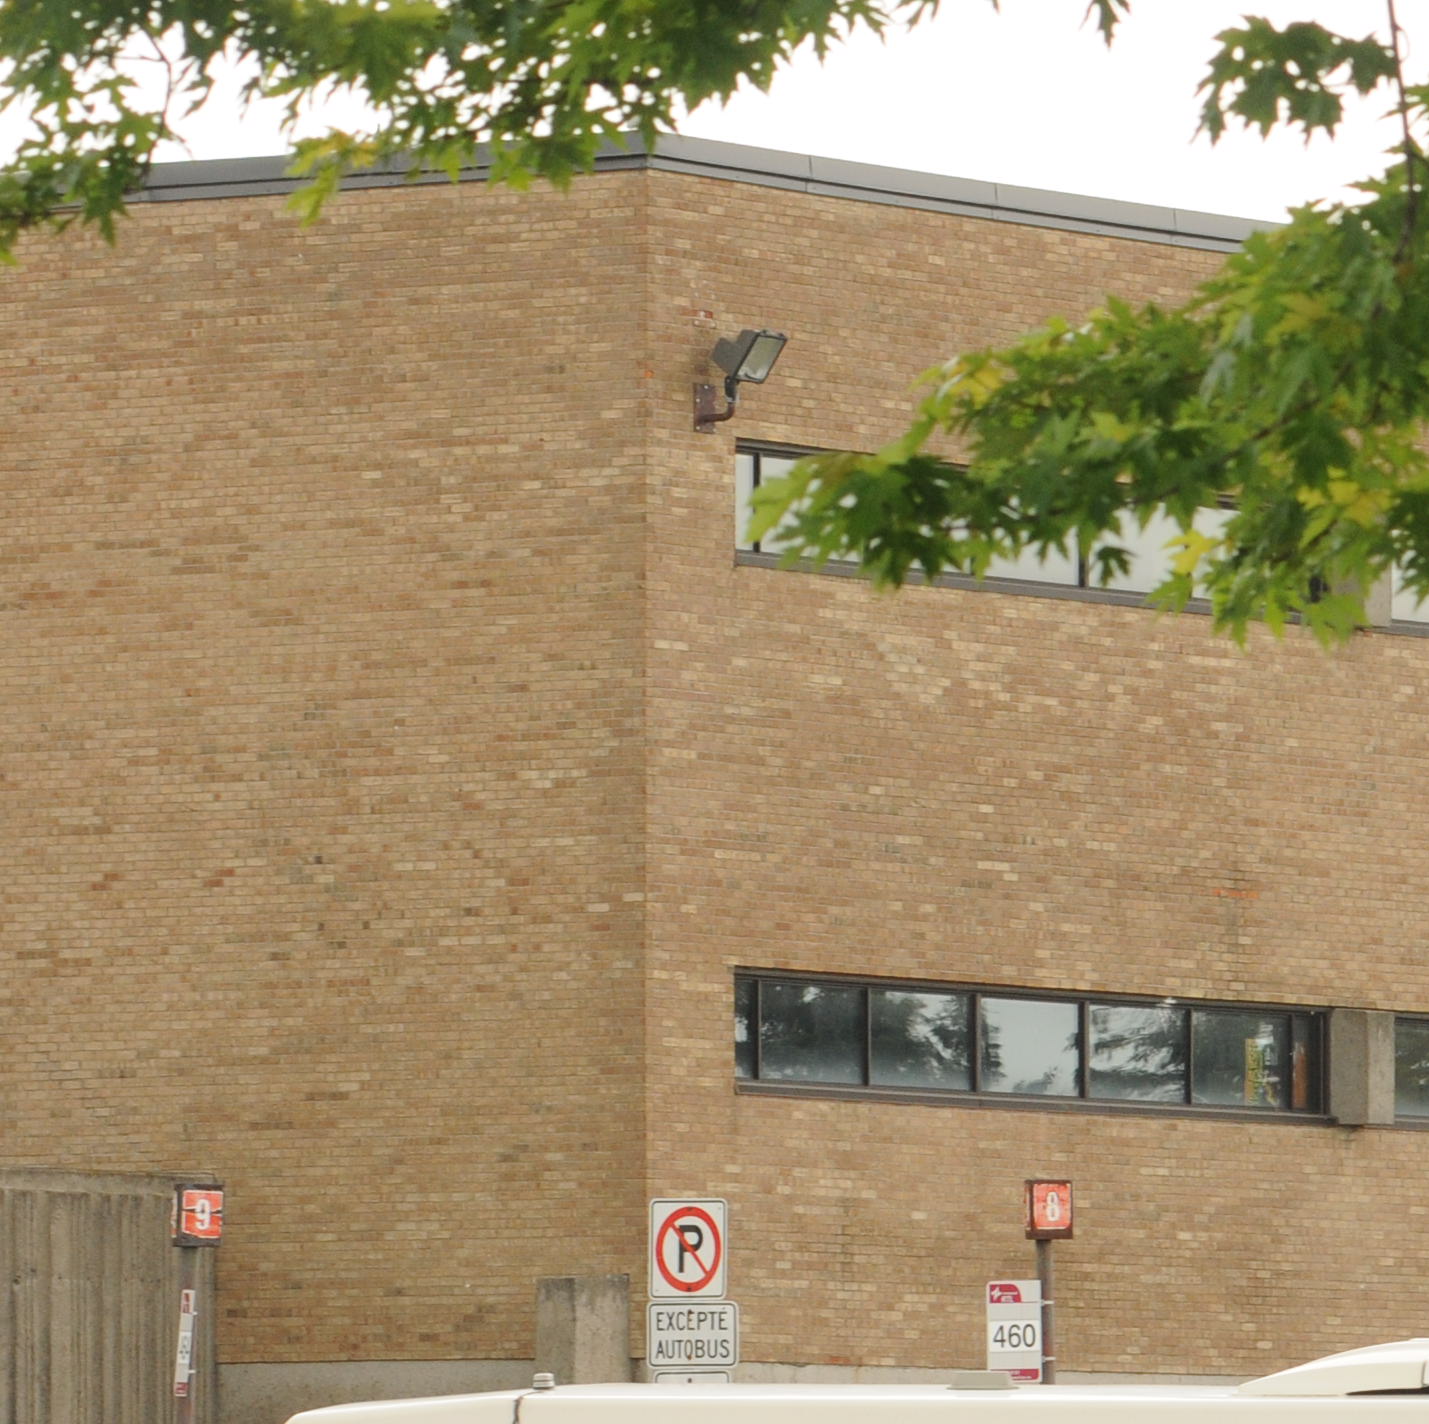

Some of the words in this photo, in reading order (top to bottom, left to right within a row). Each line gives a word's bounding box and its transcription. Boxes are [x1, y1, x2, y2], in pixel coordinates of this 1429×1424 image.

[195, 1198, 211, 1230] 9
[1046, 1191, 1060, 1221] 8
[656, 1339, 730, 1360] AUTOBUS
[993, 1324, 1036, 1348] 460
